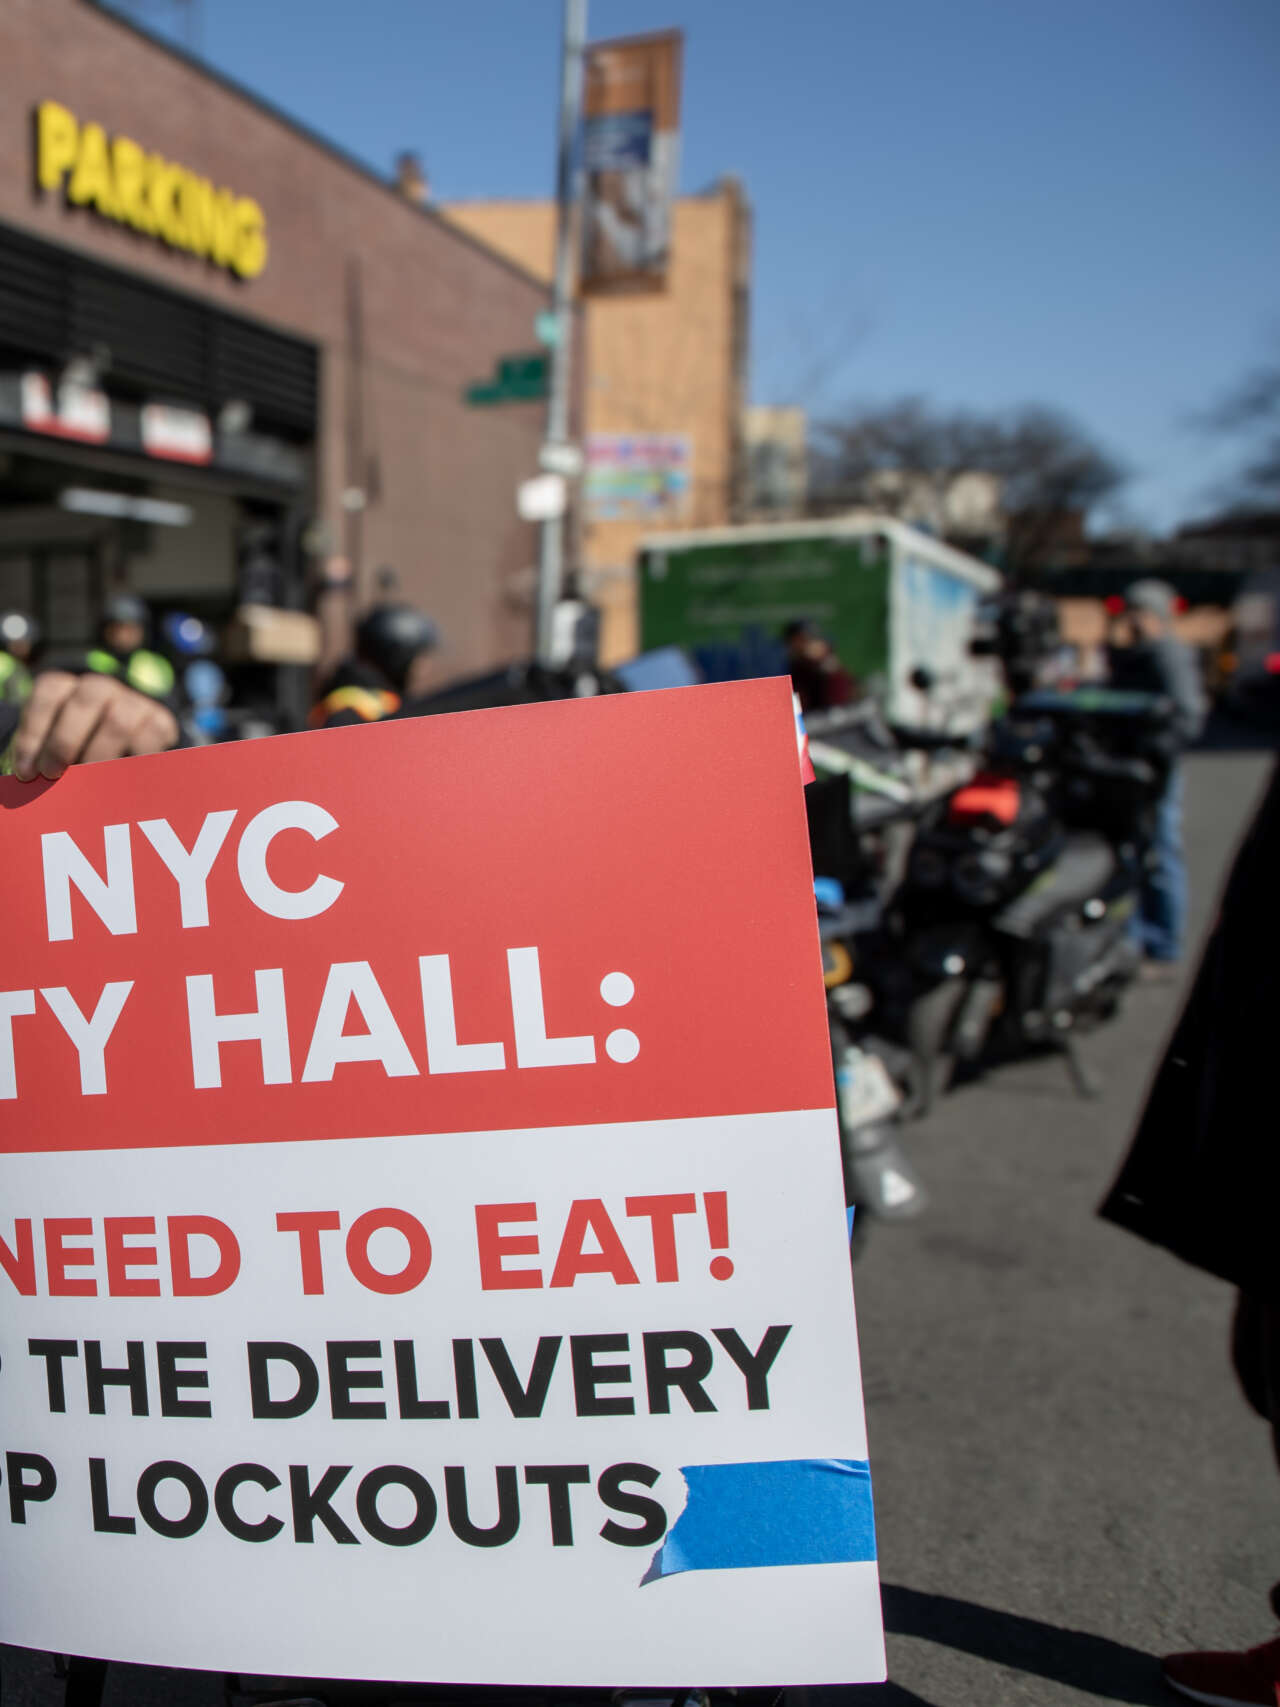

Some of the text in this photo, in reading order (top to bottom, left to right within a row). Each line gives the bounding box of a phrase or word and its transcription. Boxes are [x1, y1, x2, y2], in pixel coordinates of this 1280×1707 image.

[36, 98, 268, 278] PARKING
[41, 800, 346, 942] NYC
[185, 945, 641, 1089] HALL:
[275, 1207, 433, 1296] TO
[474, 1190, 735, 1291] EAT!
[27, 1338, 212, 1418] THE
[247, 1324, 793, 1420] DELIVERY
[88, 1457, 668, 1548] LOCKOUTS
